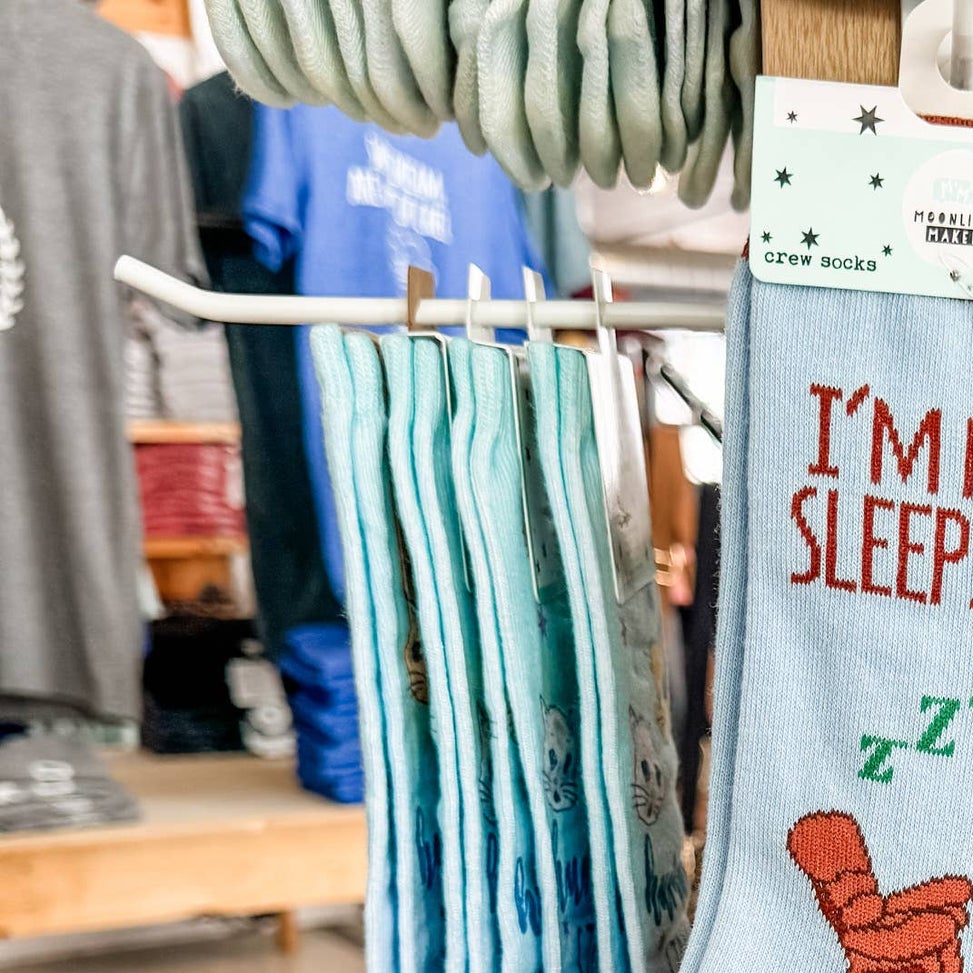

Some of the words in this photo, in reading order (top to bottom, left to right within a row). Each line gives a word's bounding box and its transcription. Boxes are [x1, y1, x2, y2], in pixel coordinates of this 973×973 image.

[764, 251, 812, 266] crew
[821, 255, 877, 272] socks
[808, 382, 942, 495] I'M
